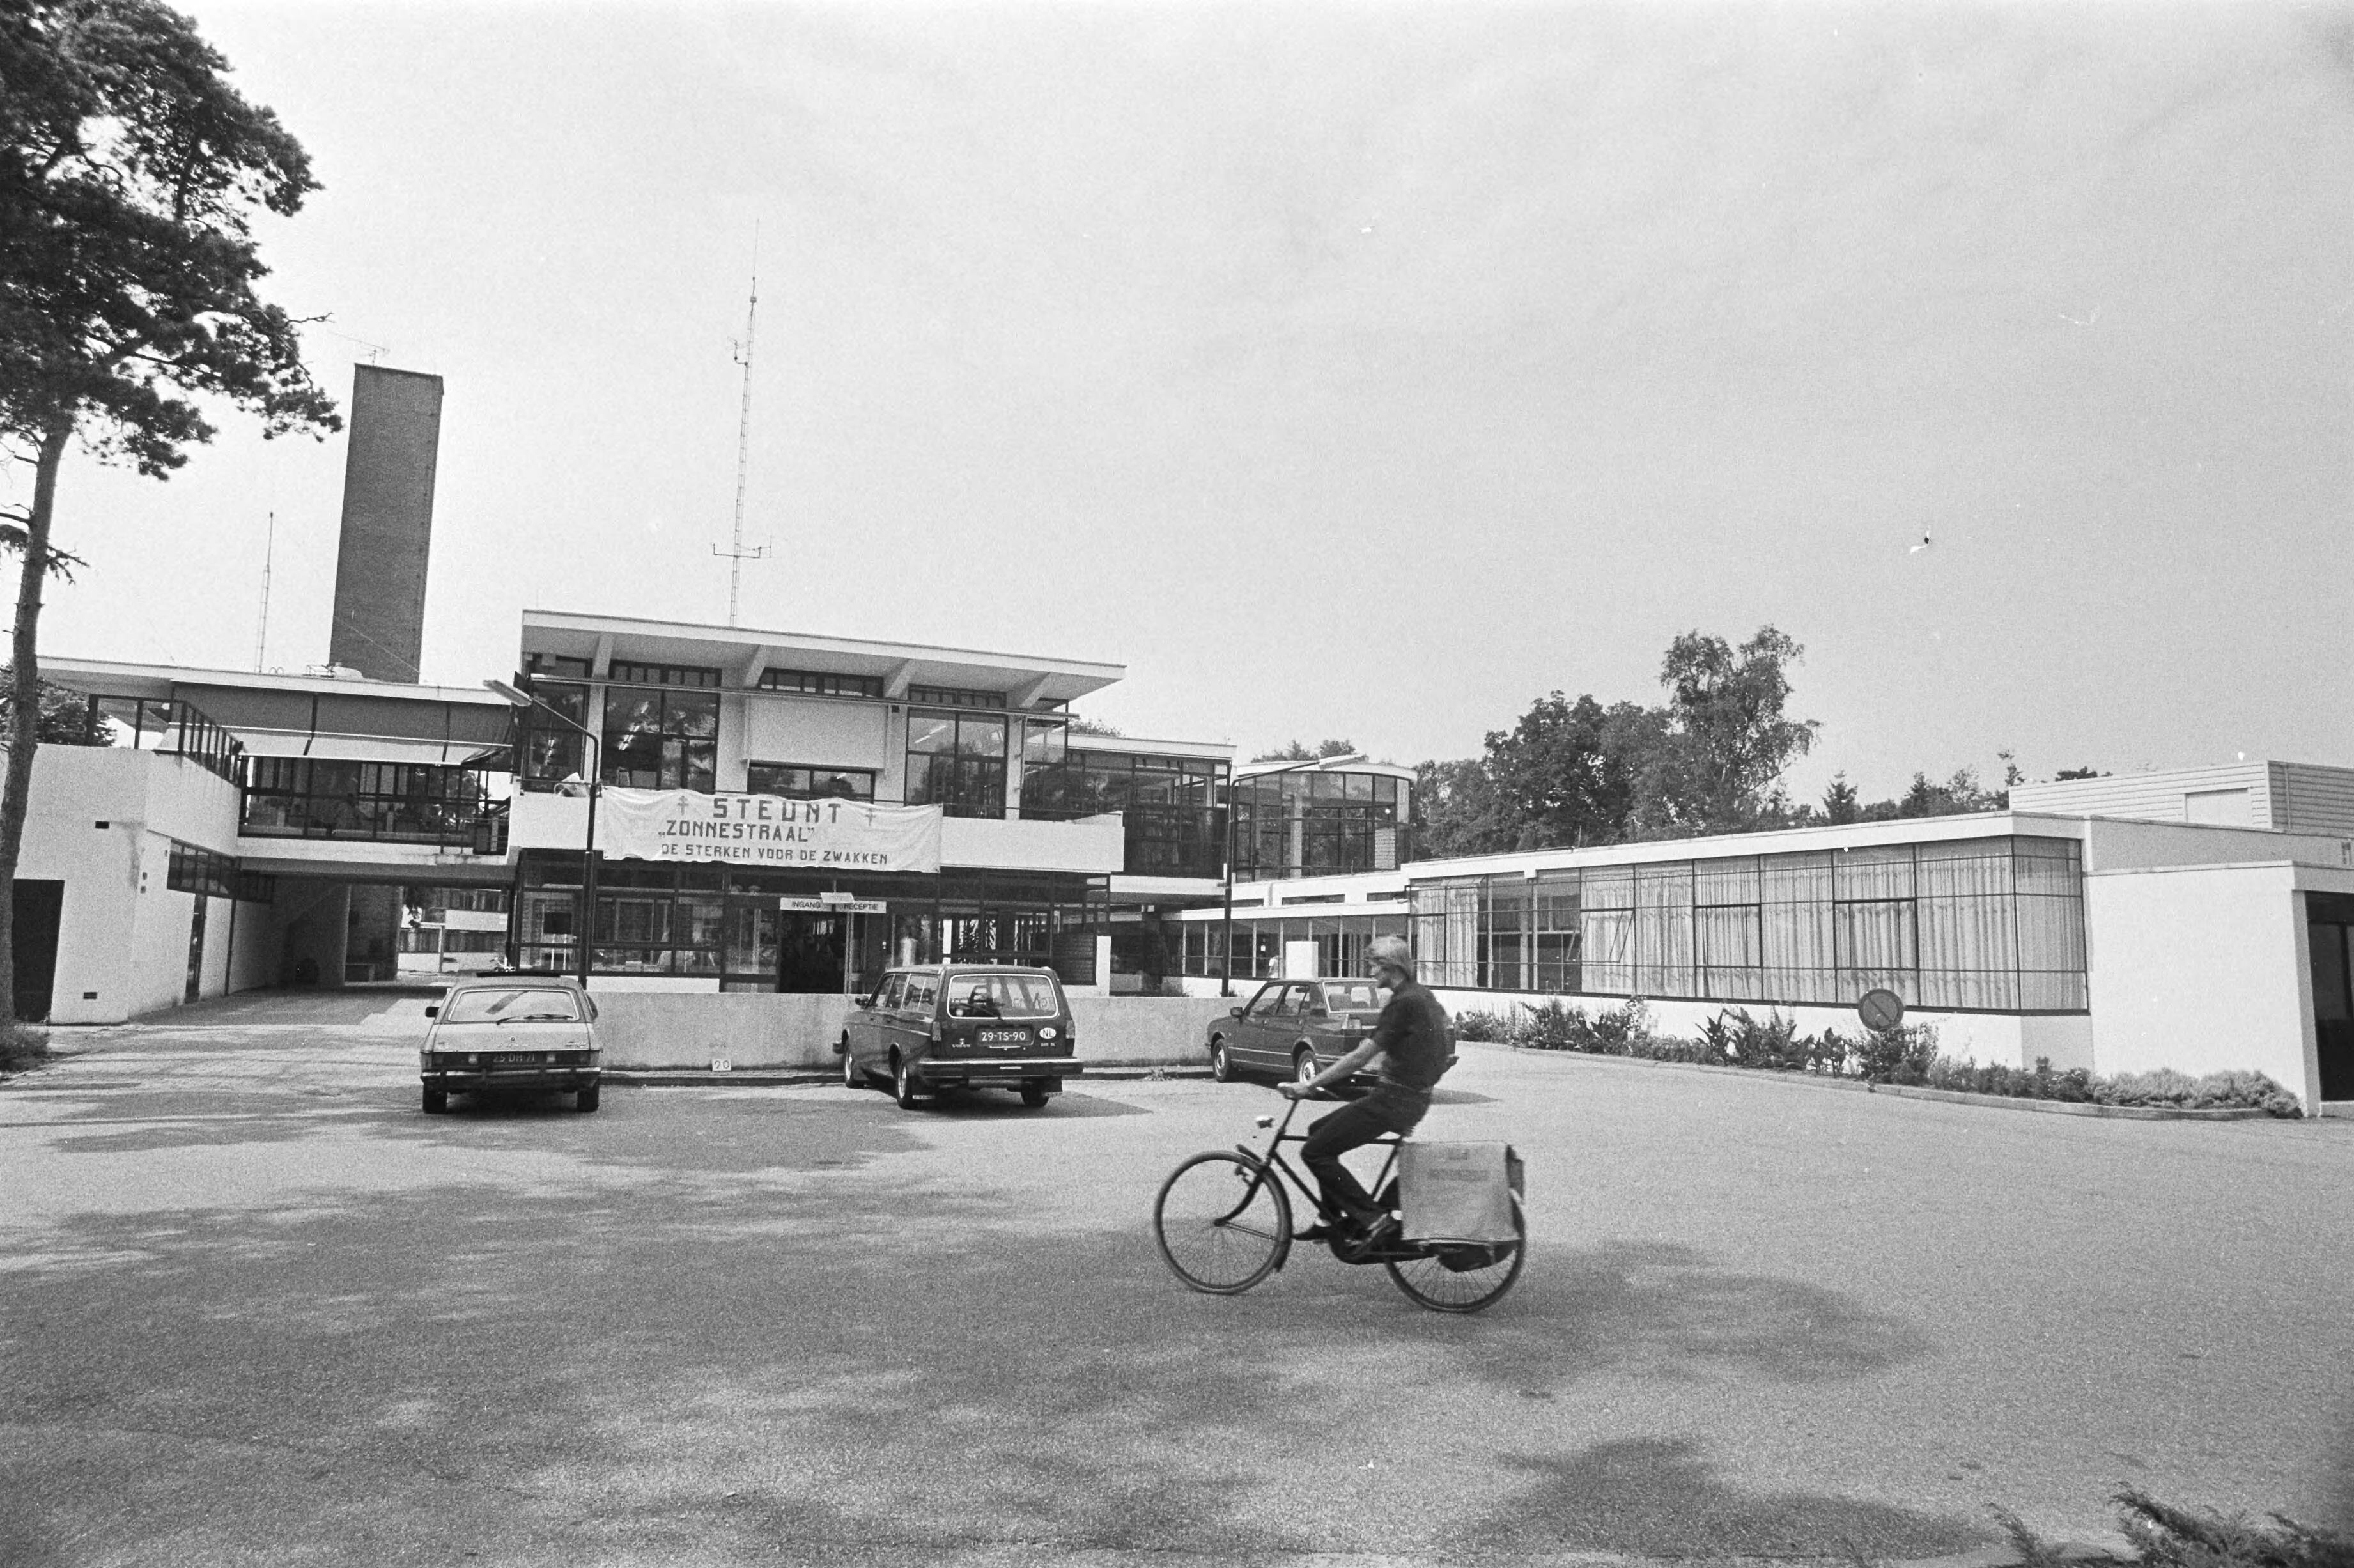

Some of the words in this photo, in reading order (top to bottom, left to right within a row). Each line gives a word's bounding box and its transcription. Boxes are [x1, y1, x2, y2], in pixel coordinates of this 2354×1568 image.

[713, 797, 841, 823] STEUNT
[662, 844, 678, 855] DE
[686, 844, 750, 858] STERKEN
[758, 848, 793, 860] VOOR
[800, 850, 817, 861] DE
[823, 850, 888, 865] ZWAKKEN
[981, 1031, 1026, 1041] 29-TS-90
[1042, 1029, 1054, 1037] NL
